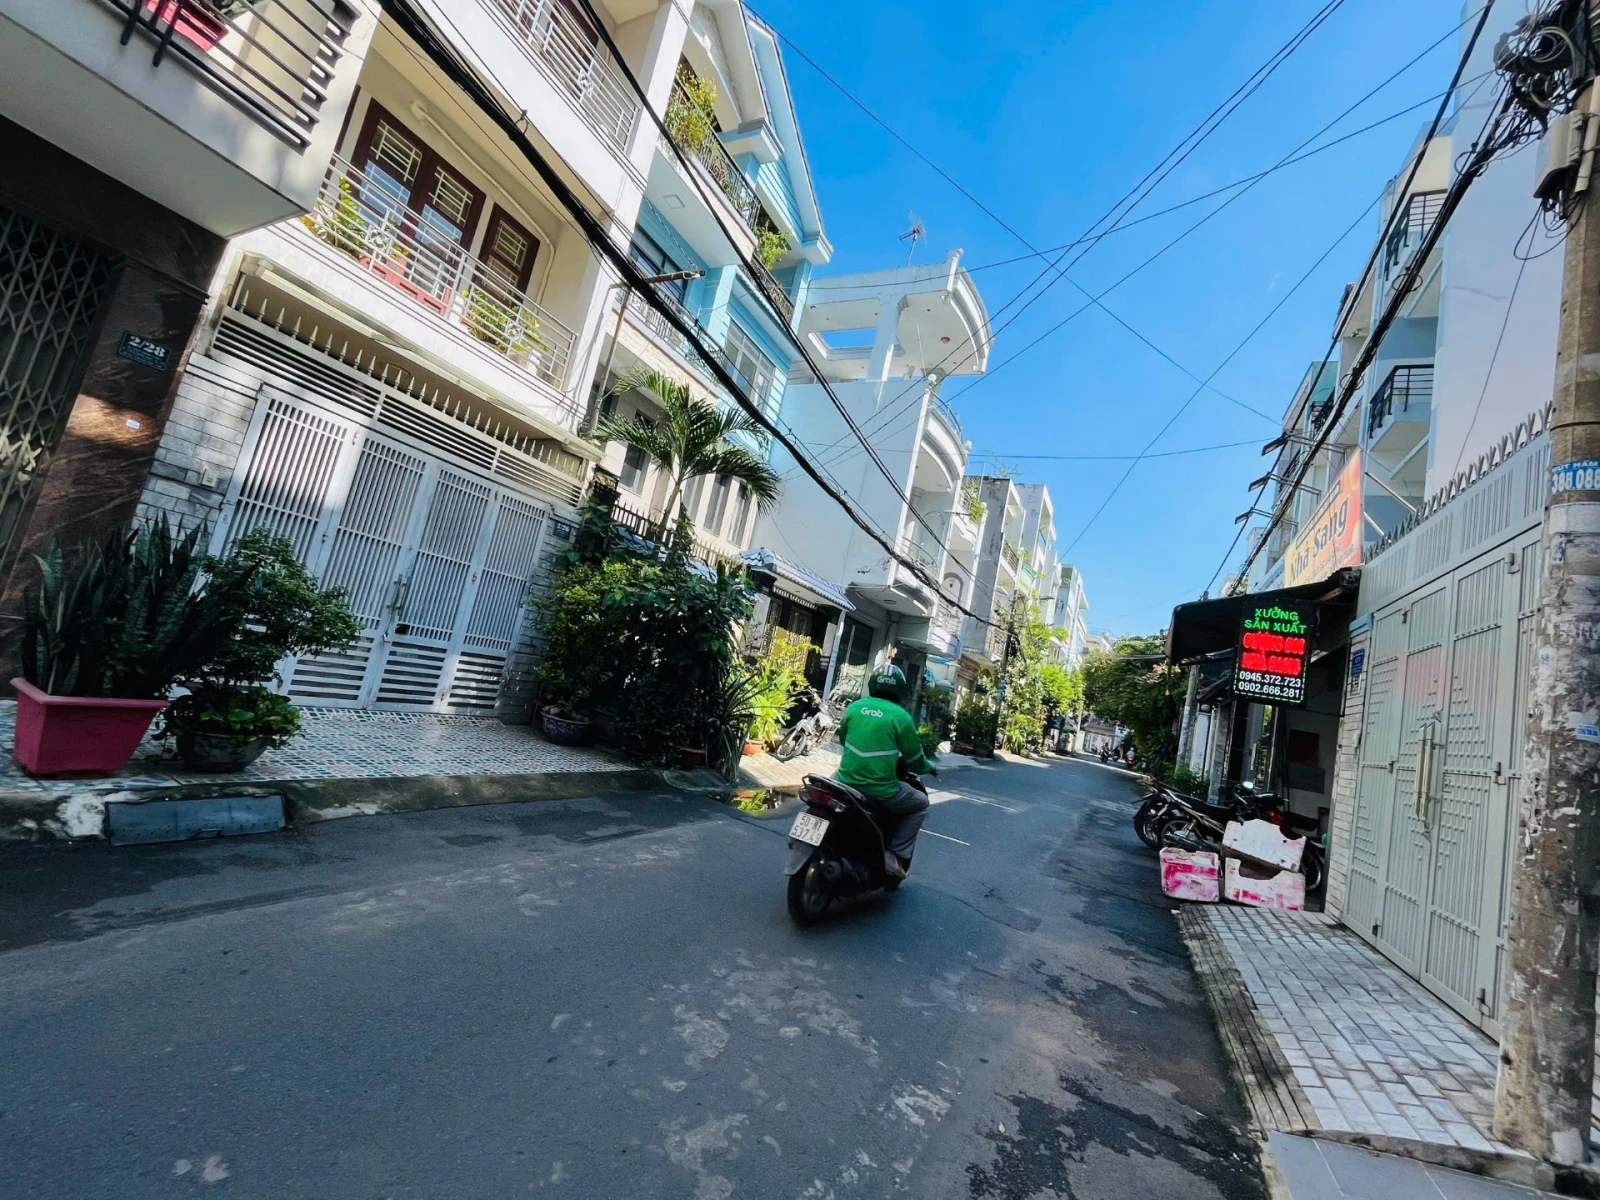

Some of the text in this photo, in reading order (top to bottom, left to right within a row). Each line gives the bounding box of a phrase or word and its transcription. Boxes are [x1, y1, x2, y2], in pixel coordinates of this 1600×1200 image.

[128, 335, 166, 358] 2/28
[1254, 606, 1299, 621] XƯỞNG
[1244, 617, 1307, 634] SẢN XUẤT
[877, 675, 897, 685] Grab
[1239, 670, 1301, 688] 0945.372.723
[1238, 681, 1300, 698] 0902.666.281
[860, 707, 884, 718] Grab
